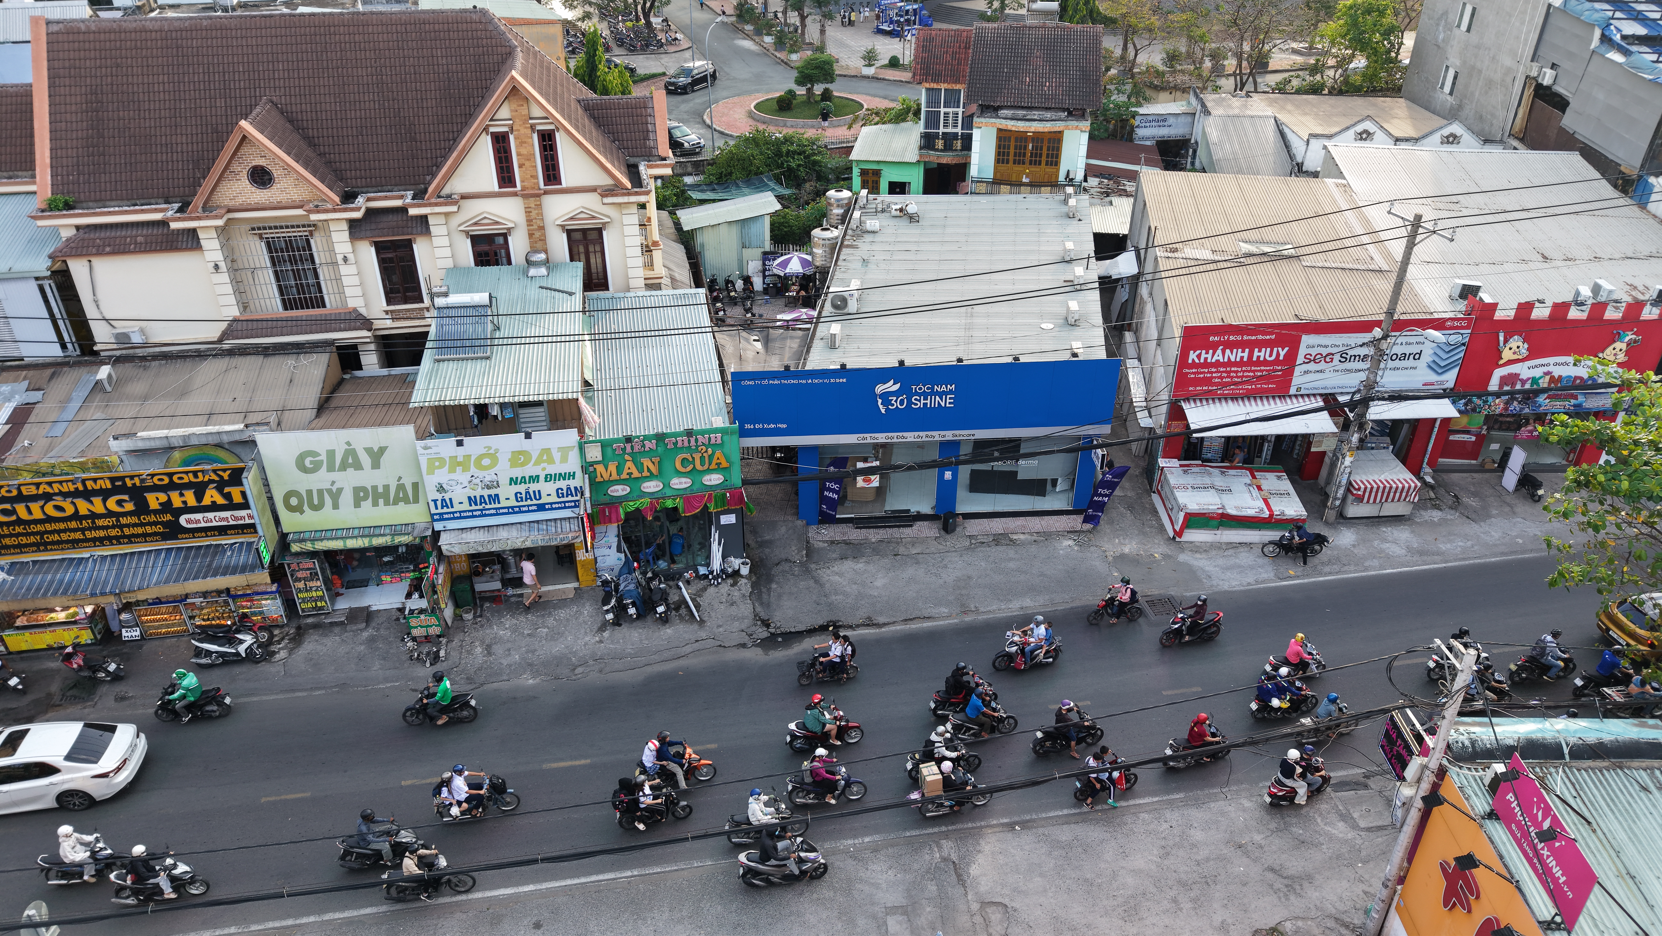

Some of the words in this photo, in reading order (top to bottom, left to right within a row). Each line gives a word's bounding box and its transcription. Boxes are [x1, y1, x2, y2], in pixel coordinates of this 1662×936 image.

[1188, 346, 1249, 363] KHÁNH
[1252, 347, 1289, 361] HUY
[1303, 352, 1334, 364] SCG
[911, 383, 932, 393] TÓC
[934, 384, 955, 392] NAM
[1498, 370, 1597, 390] MYKINGDO
[888, 394, 907, 409] 30
[911, 395, 955, 408] SHINE
[613, 436, 657, 454] TIẾN
[665, 434, 722, 449] THỊNH
[295, 440, 389, 475] GIÀY
[426, 446, 500, 475] PHỞ
[508, 446, 575, 471] ĐẠT
[594, 455, 660, 481] MÀN
[675, 446, 730, 472] CỬA
[20, 482, 84, 495] BÁNH
[85, 477, 112, 490] MÌ
[172, 470, 232, 483] QUAY
[509, 475, 540, 486] NAM
[544, 471, 576, 484] ĐỊNH
[826, 482, 840, 490] TÓC
[0, 495, 136, 522] CƯỜNG
[144, 484, 246, 510] PHÁT
[282, 480, 343, 514] QUÝ
[431, 497, 454, 510] TÁI
[468, 494, 500, 508] NẠM
[514, 486, 542, 502] GẦU
[556, 484, 583, 498] GÂN
[824, 491, 838, 500] NAM
[9, 524, 26, 534] CÁC
[45, 520, 67, 531] BÁNH
[184, 518, 202, 526] Nhận
[214, 515, 230, 524] Công
[230, 514, 245, 523] Quay
[3, 536, 19, 546] HEO
[85, 529, 108, 538] BÁNH
[123, 526, 147, 536] BÁNH
[1512, 823, 1521, 839] QUÀ
